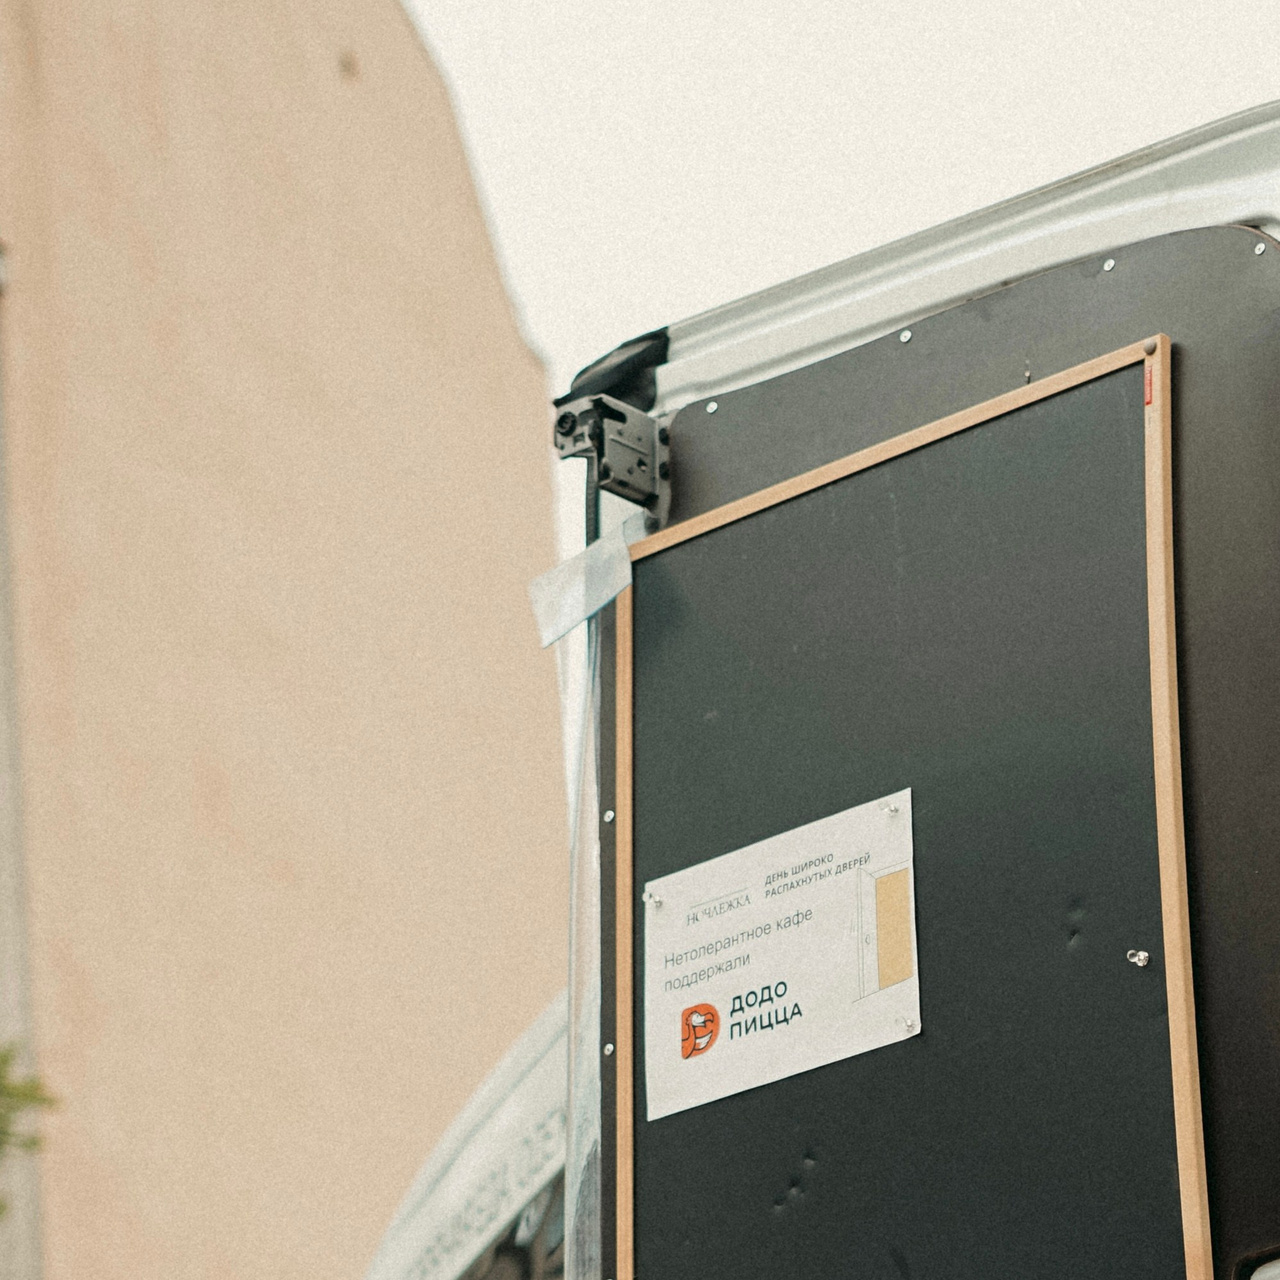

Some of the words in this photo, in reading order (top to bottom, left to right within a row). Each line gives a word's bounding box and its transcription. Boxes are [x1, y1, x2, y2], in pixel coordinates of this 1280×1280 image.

[764, 870, 789, 887] ДЕНЬ
[791, 853, 834, 876] ШИРОКО
[764, 868, 833, 899] РАСПАХНУТЫХ
[834, 851, 871, 877] ДВЕРЕЙ
[663, 922, 772, 970] Нетолерантное
[775, 907, 814, 932] кафе
[663, 953, 751, 993] поддержали
[729, 980, 788, 1018] ДОДО
[729, 1002, 803, 1040] ПИЦЦА
